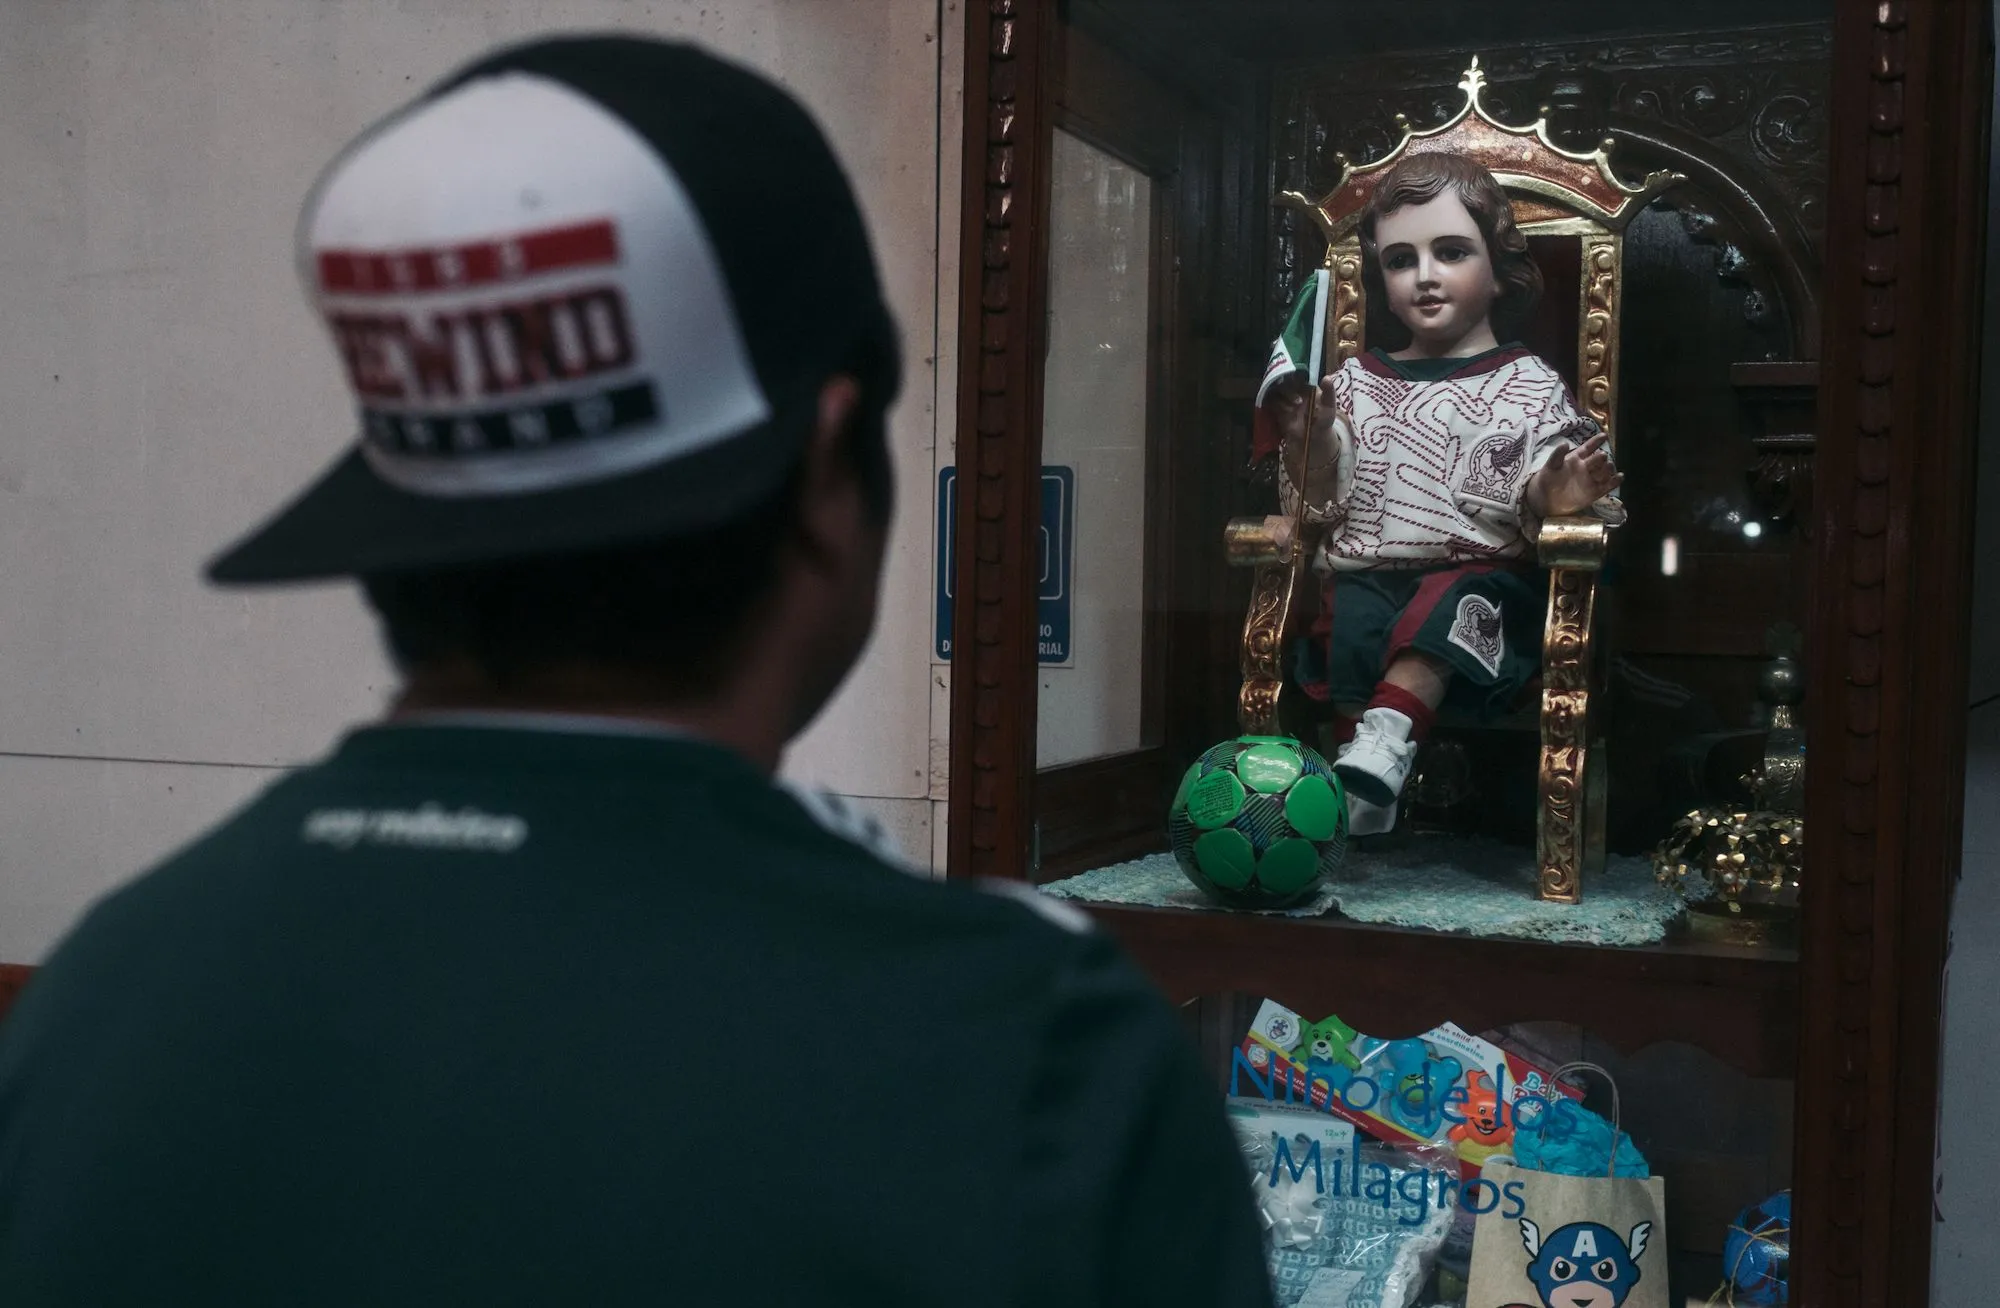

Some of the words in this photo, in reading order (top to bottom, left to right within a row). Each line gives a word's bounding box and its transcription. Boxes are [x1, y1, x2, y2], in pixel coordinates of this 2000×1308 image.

[1402, 1062, 1468, 1127] de
[1495, 1063, 1577, 1140] los
[1269, 1134, 1525, 1226] Milagros
[1572, 1230, 1598, 1257] A
